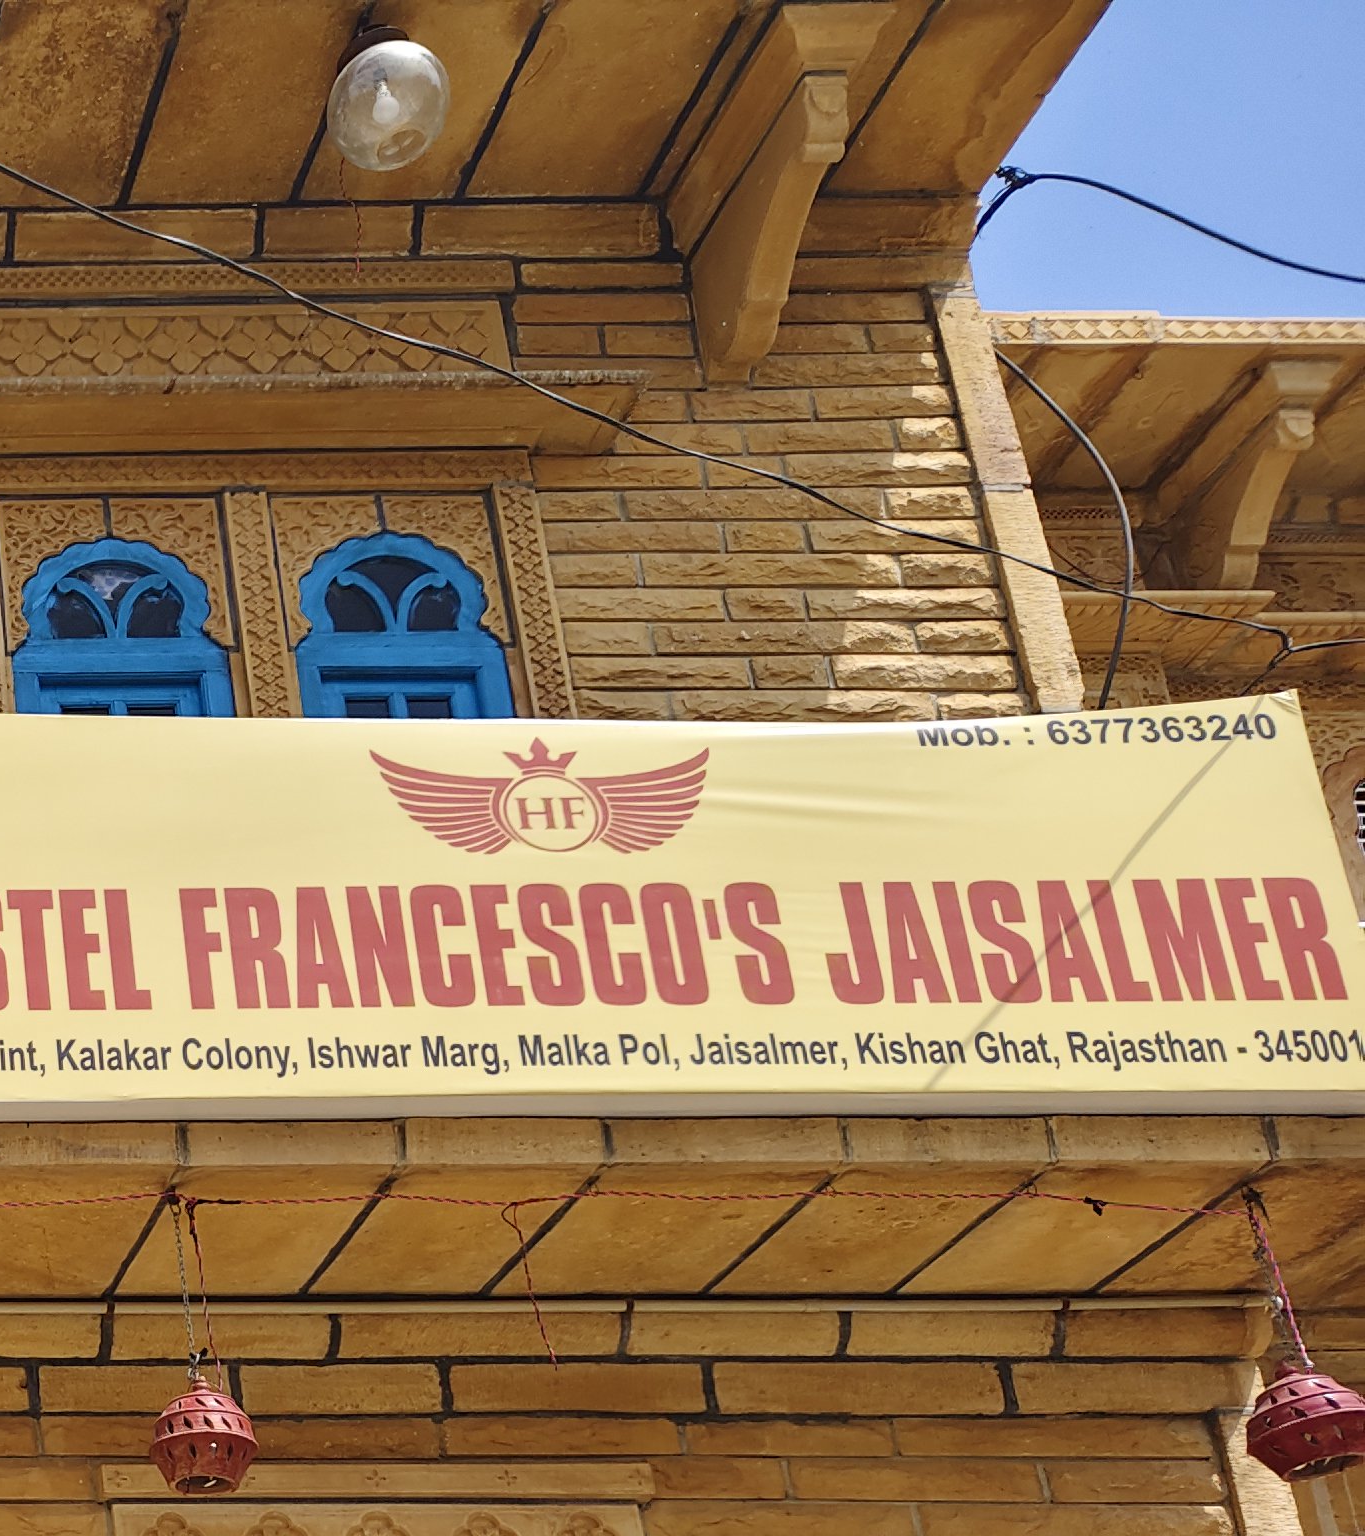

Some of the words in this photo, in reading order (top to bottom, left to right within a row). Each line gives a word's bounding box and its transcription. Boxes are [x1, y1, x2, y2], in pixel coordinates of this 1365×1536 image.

[919, 724, 1010, 748] Mob.
[1023, 726, 1035, 746] :
[1046, 713, 1277, 746] 6377363240
[515, 796, 586, 830] HF
[179, 881, 795, 1010] FRANCESCO'S
[827, 877, 1348, 1005] JAISALMER
[56, 1038, 172, 1071] Kalakar
[182, 1037, 298, 1078] Colony,
[307, 1036, 412, 1069] Ishwar
[421, 1035, 510, 1075] Marg,
[518, 1034, 611, 1067] Malka
[618, 1033, 680, 1071] Pol,
[690, 1033, 848, 1071] Jaisalmer,
[854, 1032, 966, 1065] Kishan
[974, 1031, 1060, 1069] Ghat,
[1066, 1030, 1228, 1072] Rajasthan
